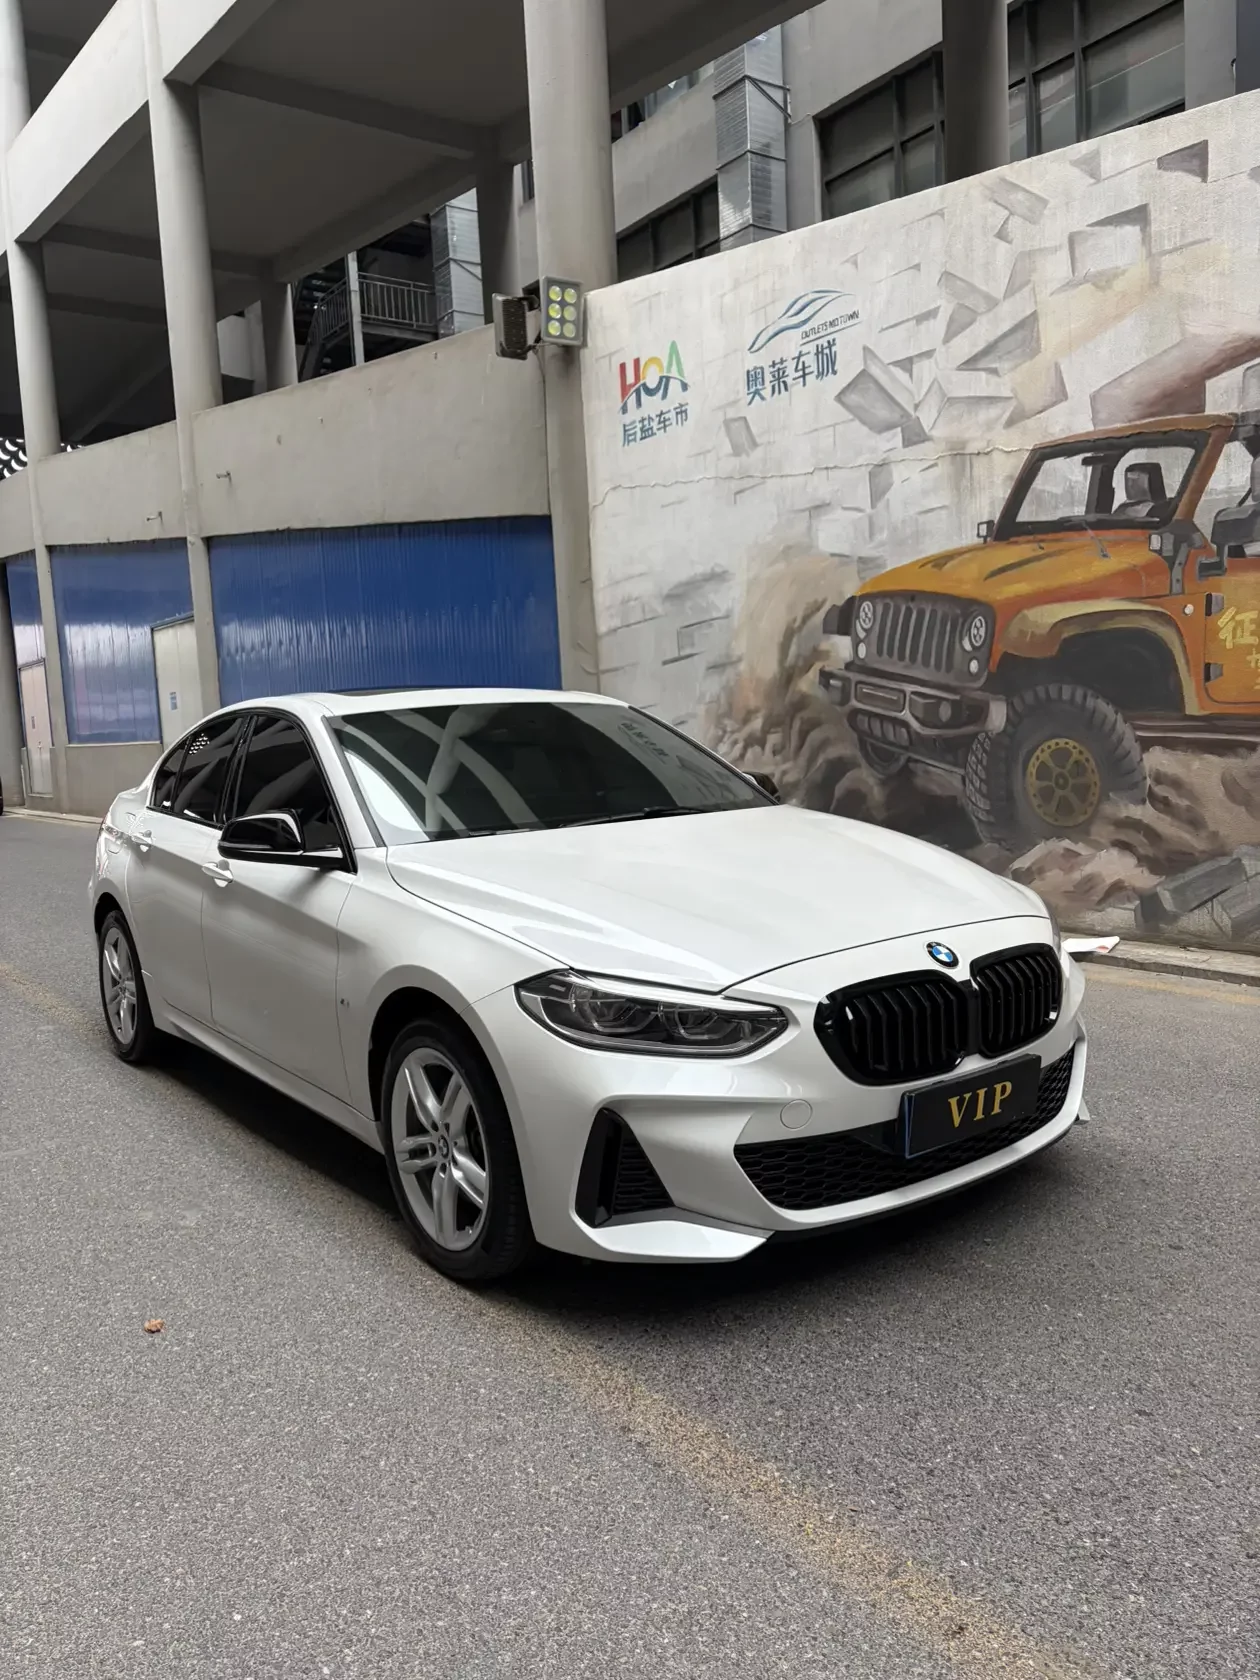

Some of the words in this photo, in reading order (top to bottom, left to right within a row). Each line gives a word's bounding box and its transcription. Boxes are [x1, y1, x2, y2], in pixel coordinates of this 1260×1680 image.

[801, 320, 828, 340] OUTLETS
[619, 340, 688, 415] HOA
[746, 338, 837, 406] 奥莱车城
[622, 402, 689, 447] 后盐车市
[948, 1081, 1012, 1129] VIP
